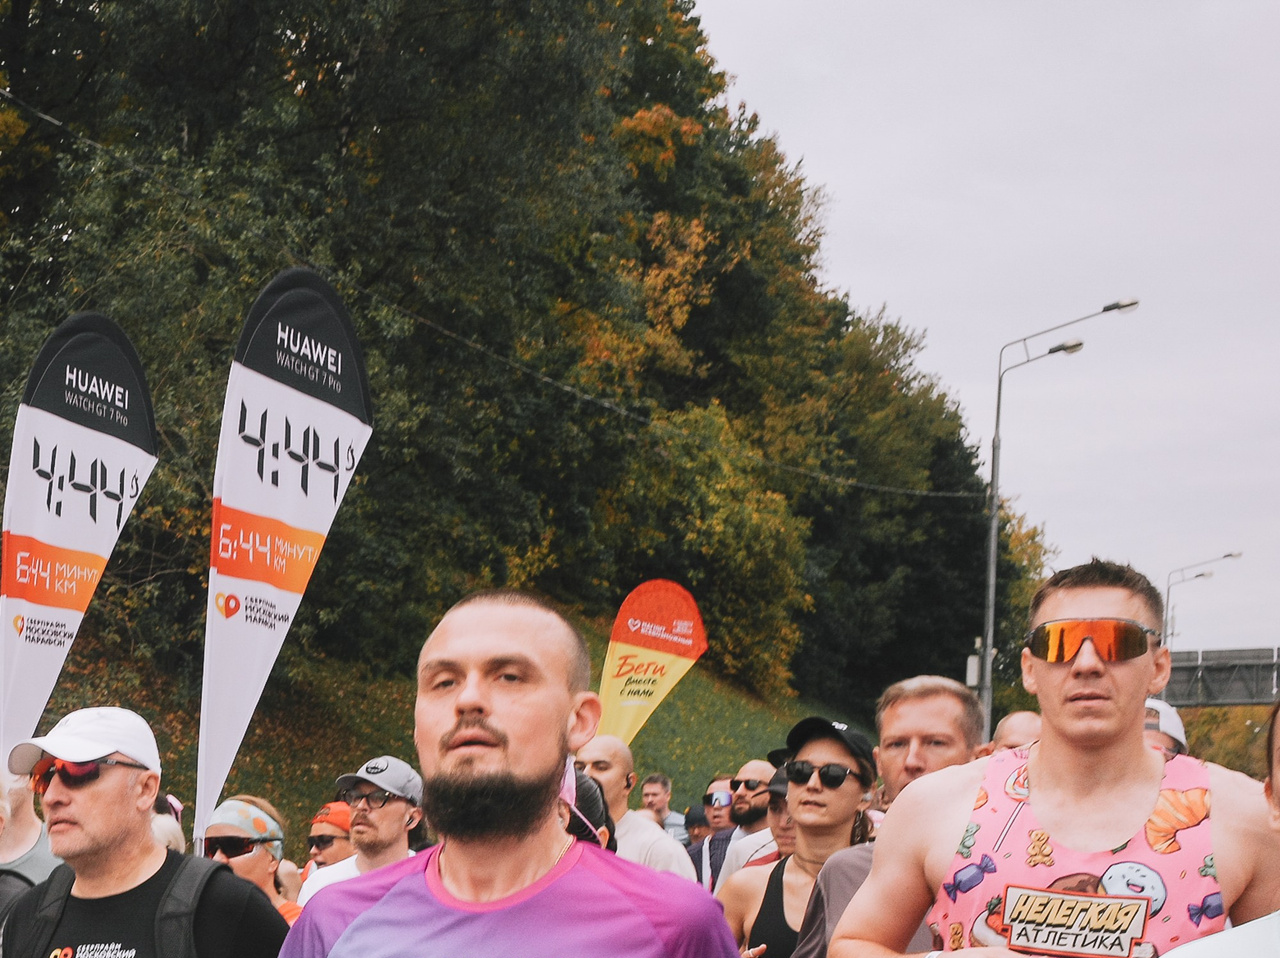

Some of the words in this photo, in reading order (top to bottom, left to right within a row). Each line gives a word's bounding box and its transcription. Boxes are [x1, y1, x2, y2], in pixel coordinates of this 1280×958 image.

[277, 321, 342, 376] HUAWEI
[65, 364, 129, 410] HUAWEI
[276, 349, 307, 378] WATCH
[308, 365, 320, 382] GT
[322, 371, 328, 386] 7
[329, 374, 342, 394] Pro
[64, 390, 95, 414] WATCH
[96, 403, 108, 417] GT
[109, 407, 115, 420] 7
[115, 410, 129, 427] Pro
[238, 398, 340, 506] 4:44
[32, 436, 126, 531] 4:44
[219, 523, 271, 567] 6:44
[274, 553, 287, 575] КМ
[55, 579, 76, 596] КМ
[612, 654, 667, 679] Беги
[627, 688, 655, 698] нами
[1009, 893, 1142, 935] НЕЛЕГКАЯ
[1015, 926, 1125, 953] АТЛЕТИКА
